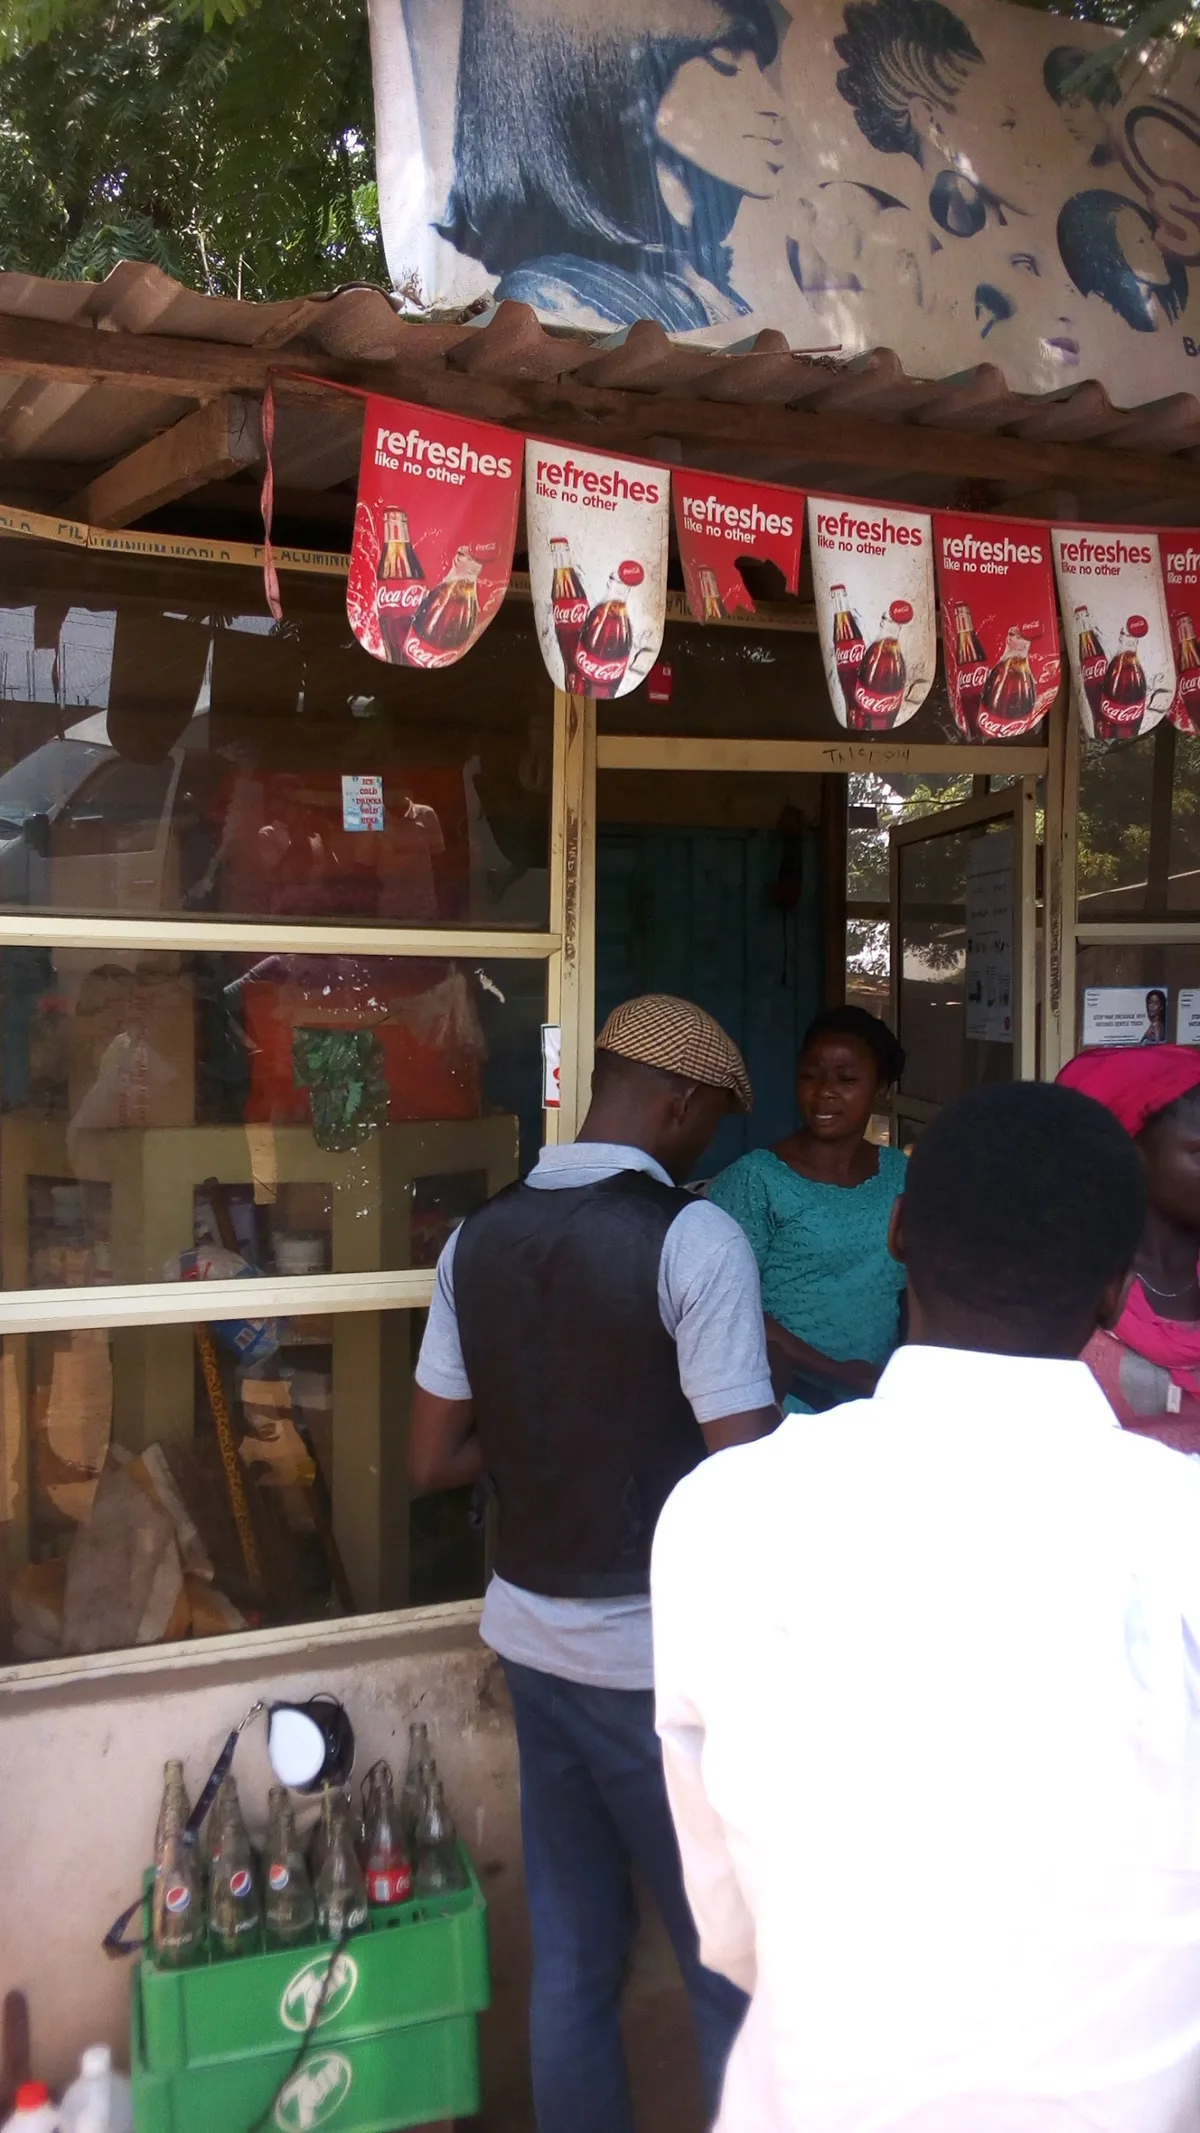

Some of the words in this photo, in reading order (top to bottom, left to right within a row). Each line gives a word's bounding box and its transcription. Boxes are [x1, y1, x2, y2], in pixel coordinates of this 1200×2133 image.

[374, 450, 399, 470] like
[403, 461, 422, 475] no
[426, 466, 466, 485] other
[376, 428, 512, 479] refreshes
[537, 460, 659, 504] refreshes
[536, 482, 557, 499] like
[561, 491, 578, 503] no
[582, 495, 618, 511] other
[683, 495, 793, 537] refreshes
[684, 516, 702, 533] like
[706, 525, 721, 537] no
[724, 528, 756, 544] other
[817, 512, 923, 546] refreshes
[817, 534, 835, 549] like
[838, 541, 853, 552] no
[856, 542, 886, 556] other
[943, 533, 1043, 564] refreshes
[1060, 538, 1152, 564] refreshes
[944, 556, 960, 571] like
[963, 562, 977, 573] no
[980, 561, 1009, 575] other
[1061, 562, 1077, 574] like
[1080, 565, 1092, 575] no
[1095, 564, 1121, 576] other
[1167, 548, 1200, 572] refr
[1185, 575, 1198, 584] no
